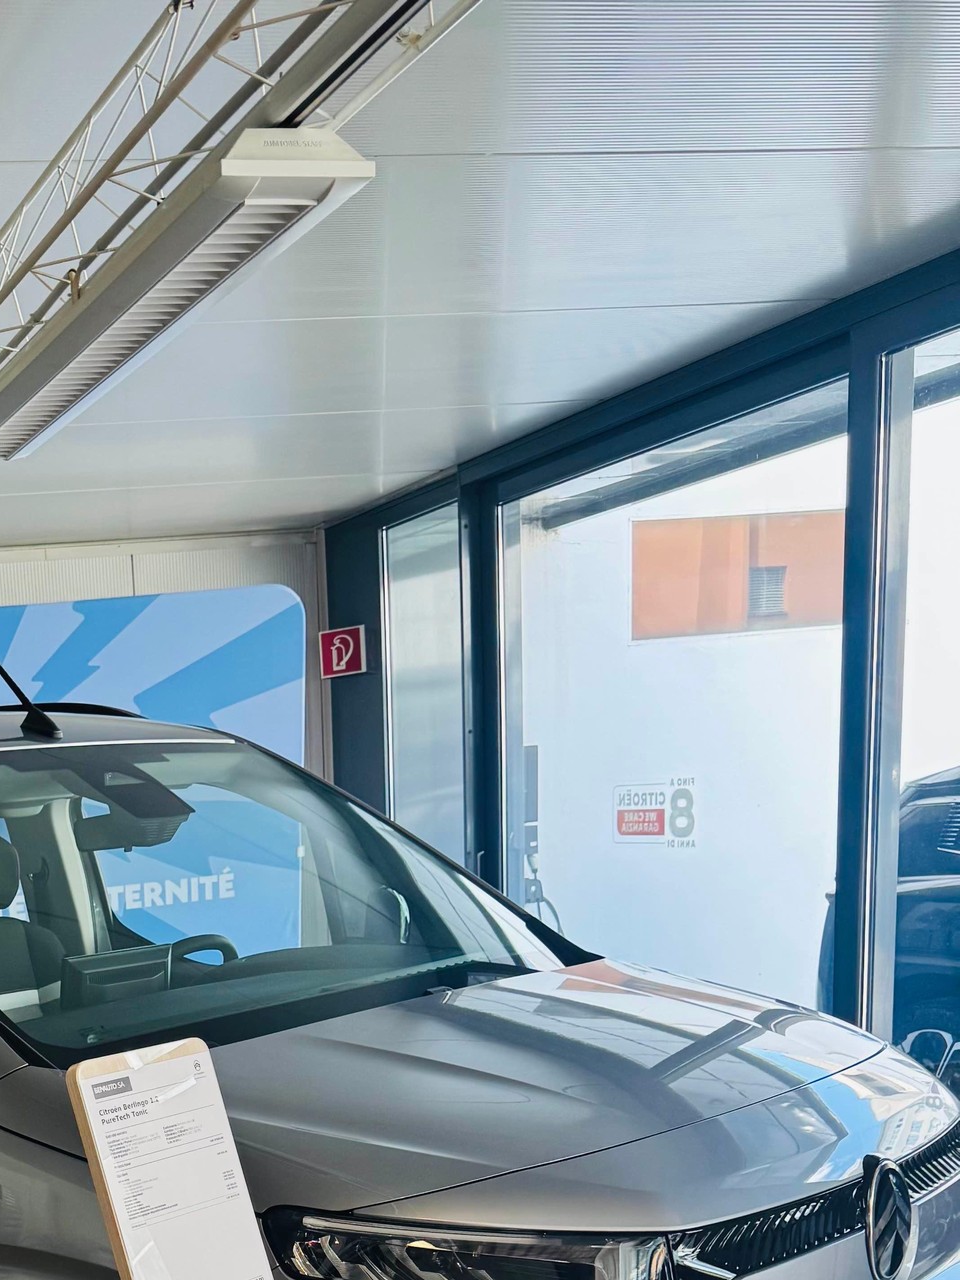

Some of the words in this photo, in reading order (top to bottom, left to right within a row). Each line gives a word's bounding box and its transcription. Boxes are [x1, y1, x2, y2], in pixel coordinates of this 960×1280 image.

[99, 1105, 122, 1116] Citroën
[123, 1100, 149, 1111] Berlingo
[101, 1113, 130, 1125] PureTech
[131, 1109, 148, 1118] Tonic
